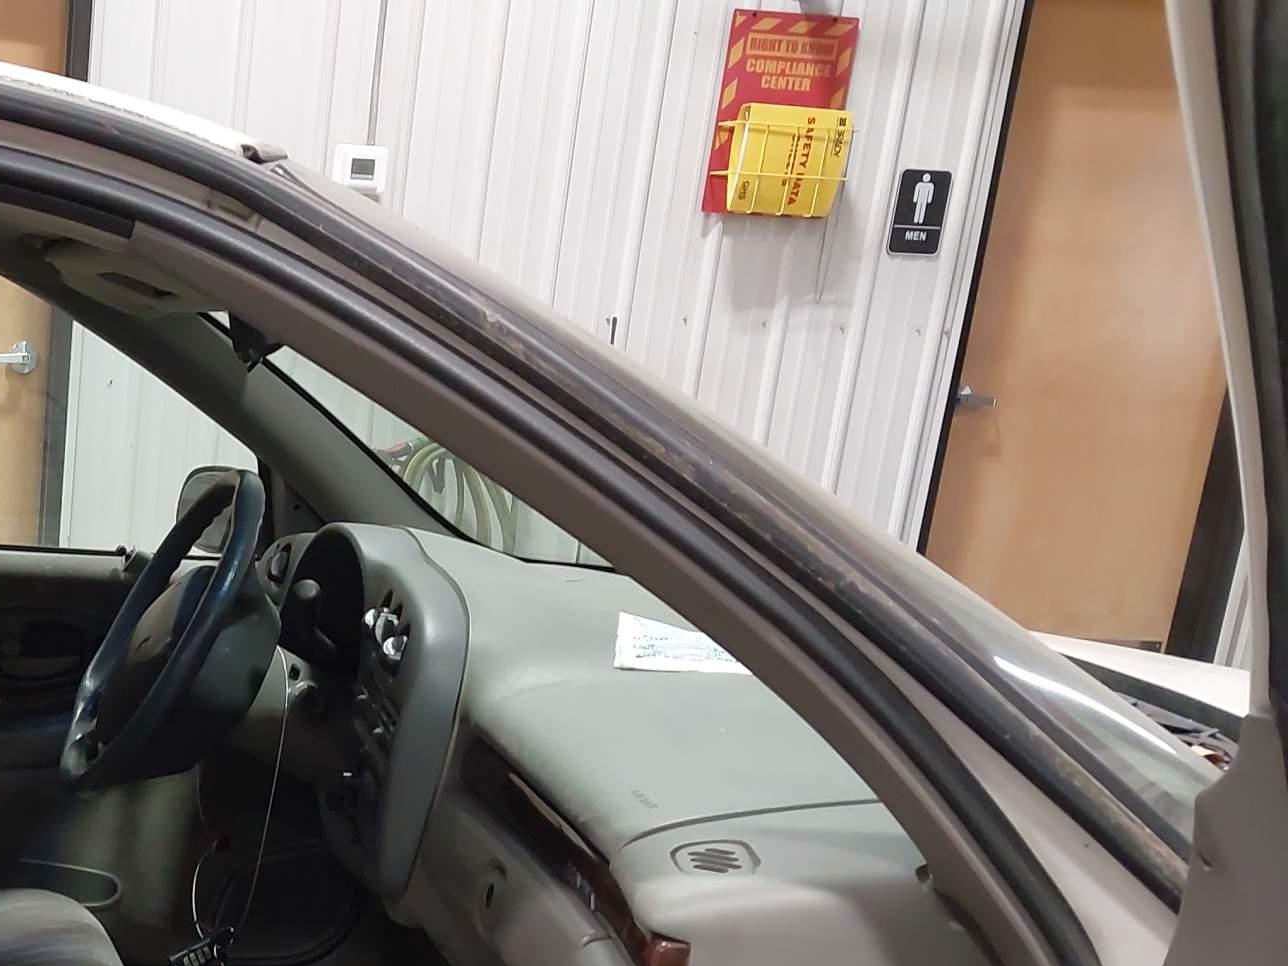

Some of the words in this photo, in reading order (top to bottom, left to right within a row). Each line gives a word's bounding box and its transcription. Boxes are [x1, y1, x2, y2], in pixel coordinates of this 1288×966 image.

[749, 37, 782, 53] RIGHT
[785, 39, 800, 54] TO
[746, 58, 832, 77] COMPLIANCE
[760, 75, 811, 91] CENTER
[799, 116, 816, 168] SAFETY
[905, 230, 927, 241] MEN
